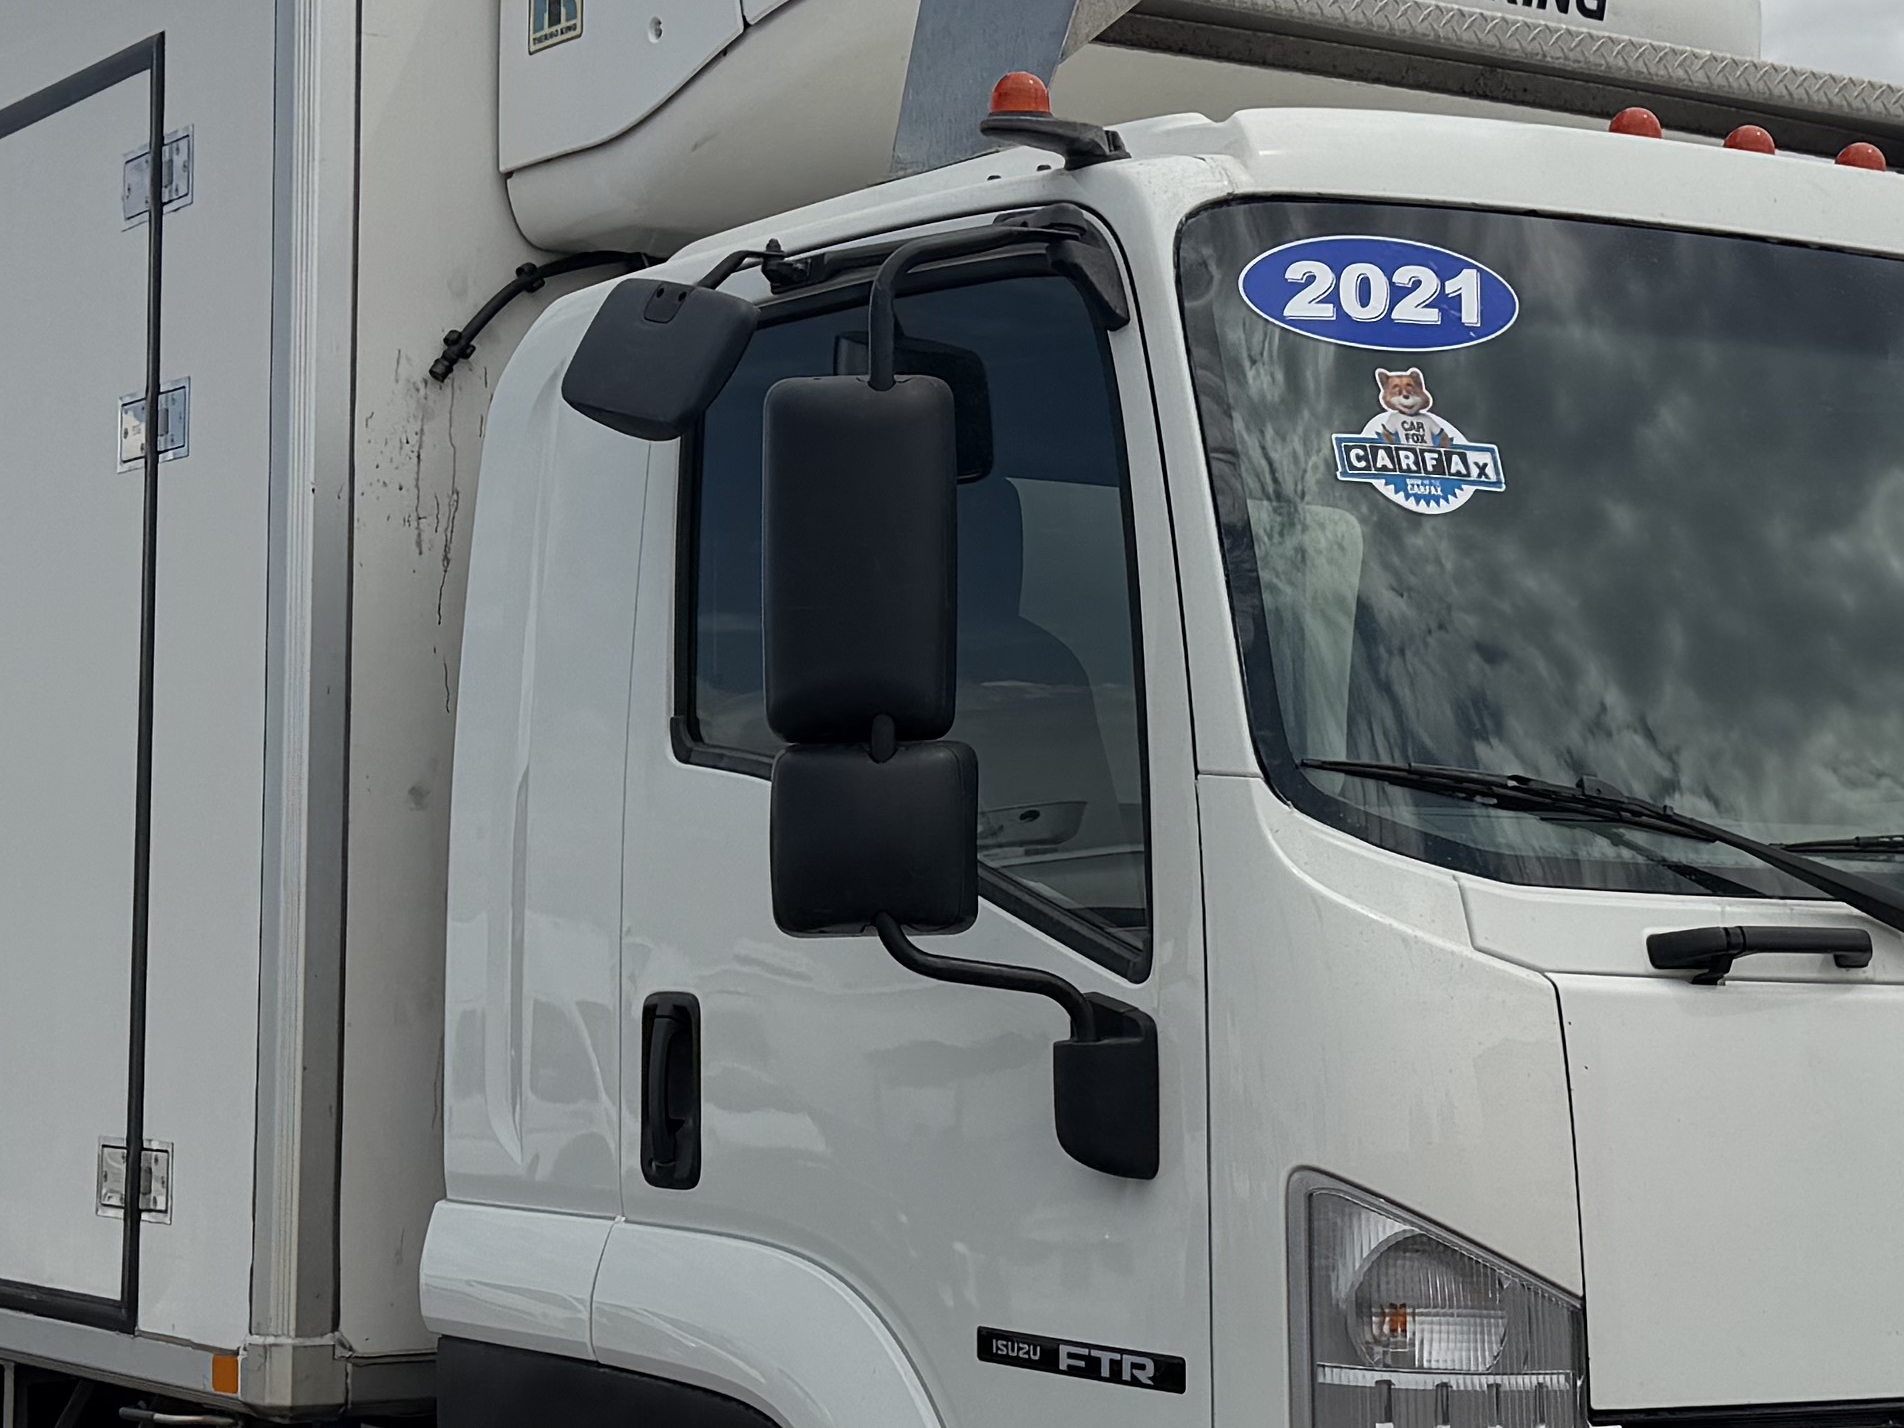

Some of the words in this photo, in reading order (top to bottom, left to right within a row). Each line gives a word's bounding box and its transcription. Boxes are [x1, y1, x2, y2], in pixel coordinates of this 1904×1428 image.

[1282, 259, 1482, 327] 2021
[1400, 420, 1426, 433] CAR
[1404, 432, 1428, 444] FOX
[1348, 447, 1492, 480] CARFAX
[992, 1338, 1041, 1360] ISUZU
[1058, 1344, 1155, 1386] FTR
